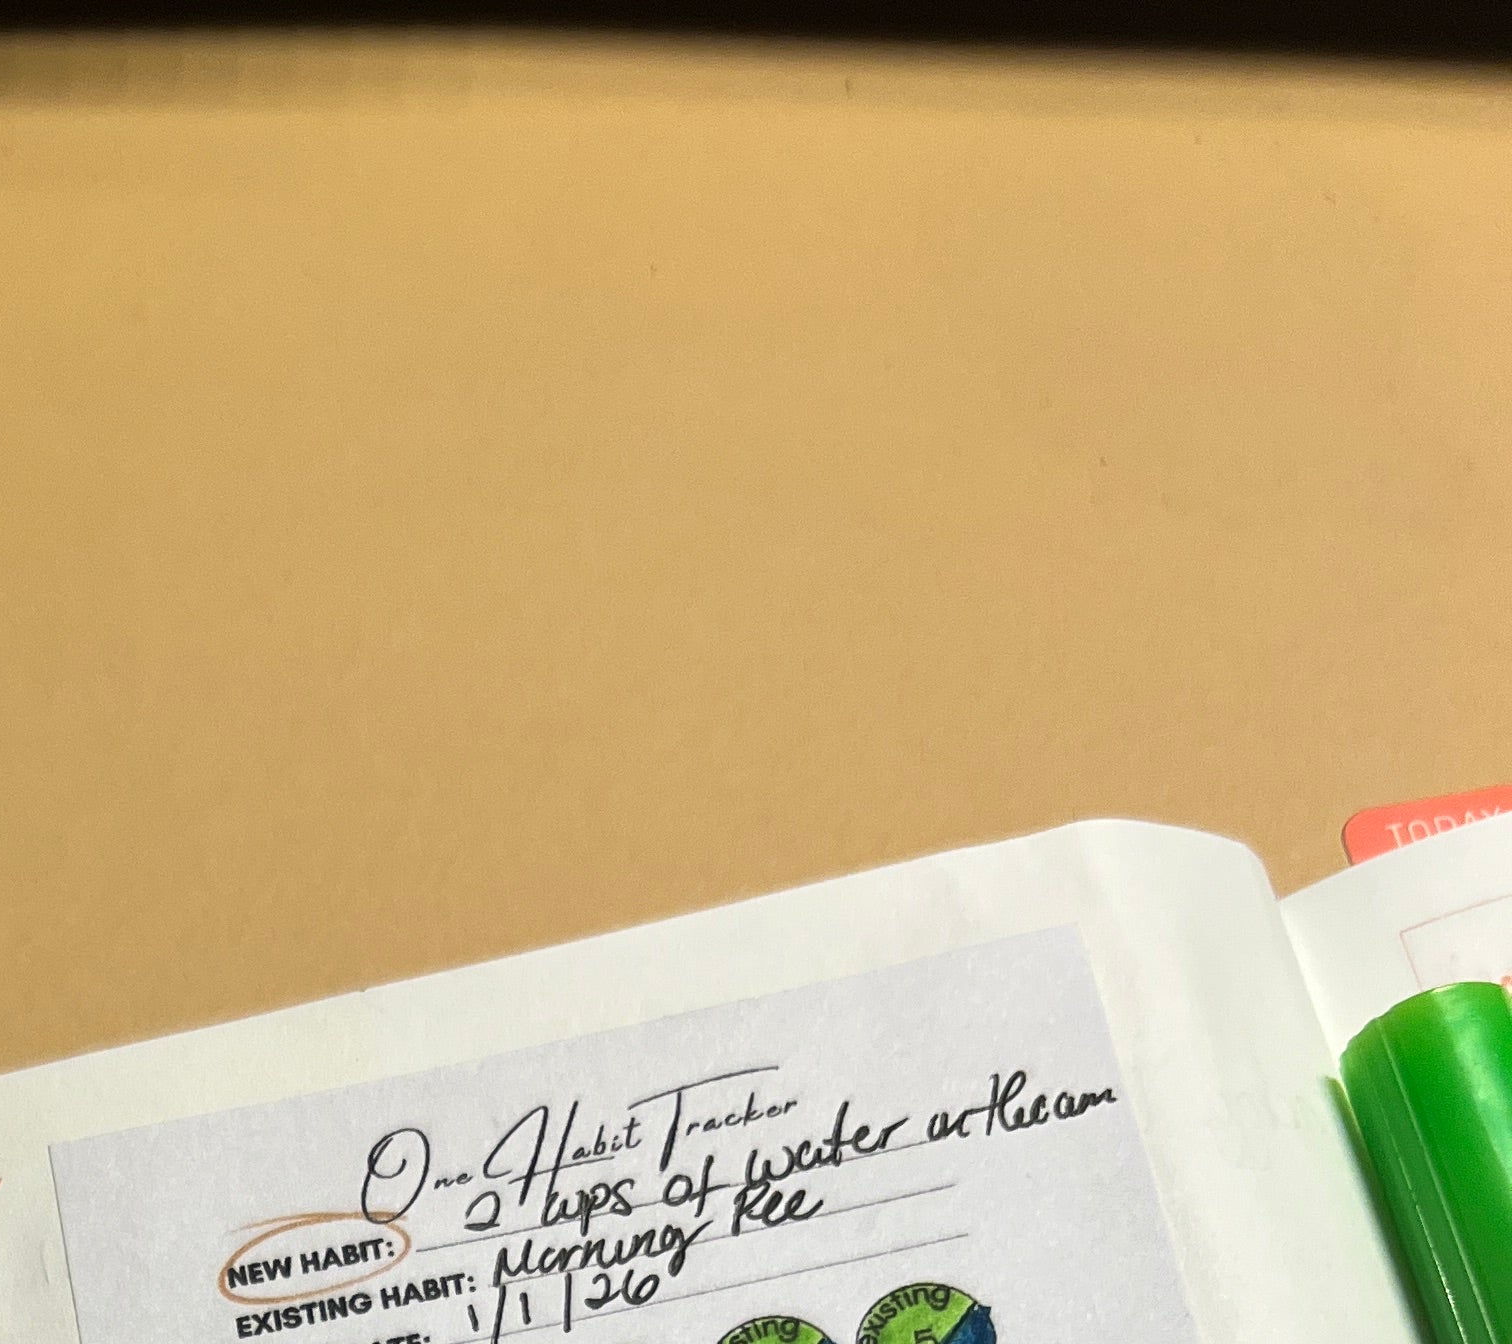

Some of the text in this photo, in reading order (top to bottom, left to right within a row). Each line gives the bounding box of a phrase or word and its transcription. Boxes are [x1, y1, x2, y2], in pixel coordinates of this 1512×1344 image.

[361, 1065, 798, 1224] One Habit Tracker
[464, 1190, 501, 1231] 2
[663, 1154, 729, 1217] of
[745, 1101, 909, 1188] water
[227, 1238, 395, 1290] NEW HABIT:
[491, 1217, 714, 1288] Morning
[235, 1273, 477, 1339] EXISTING HABIT:
